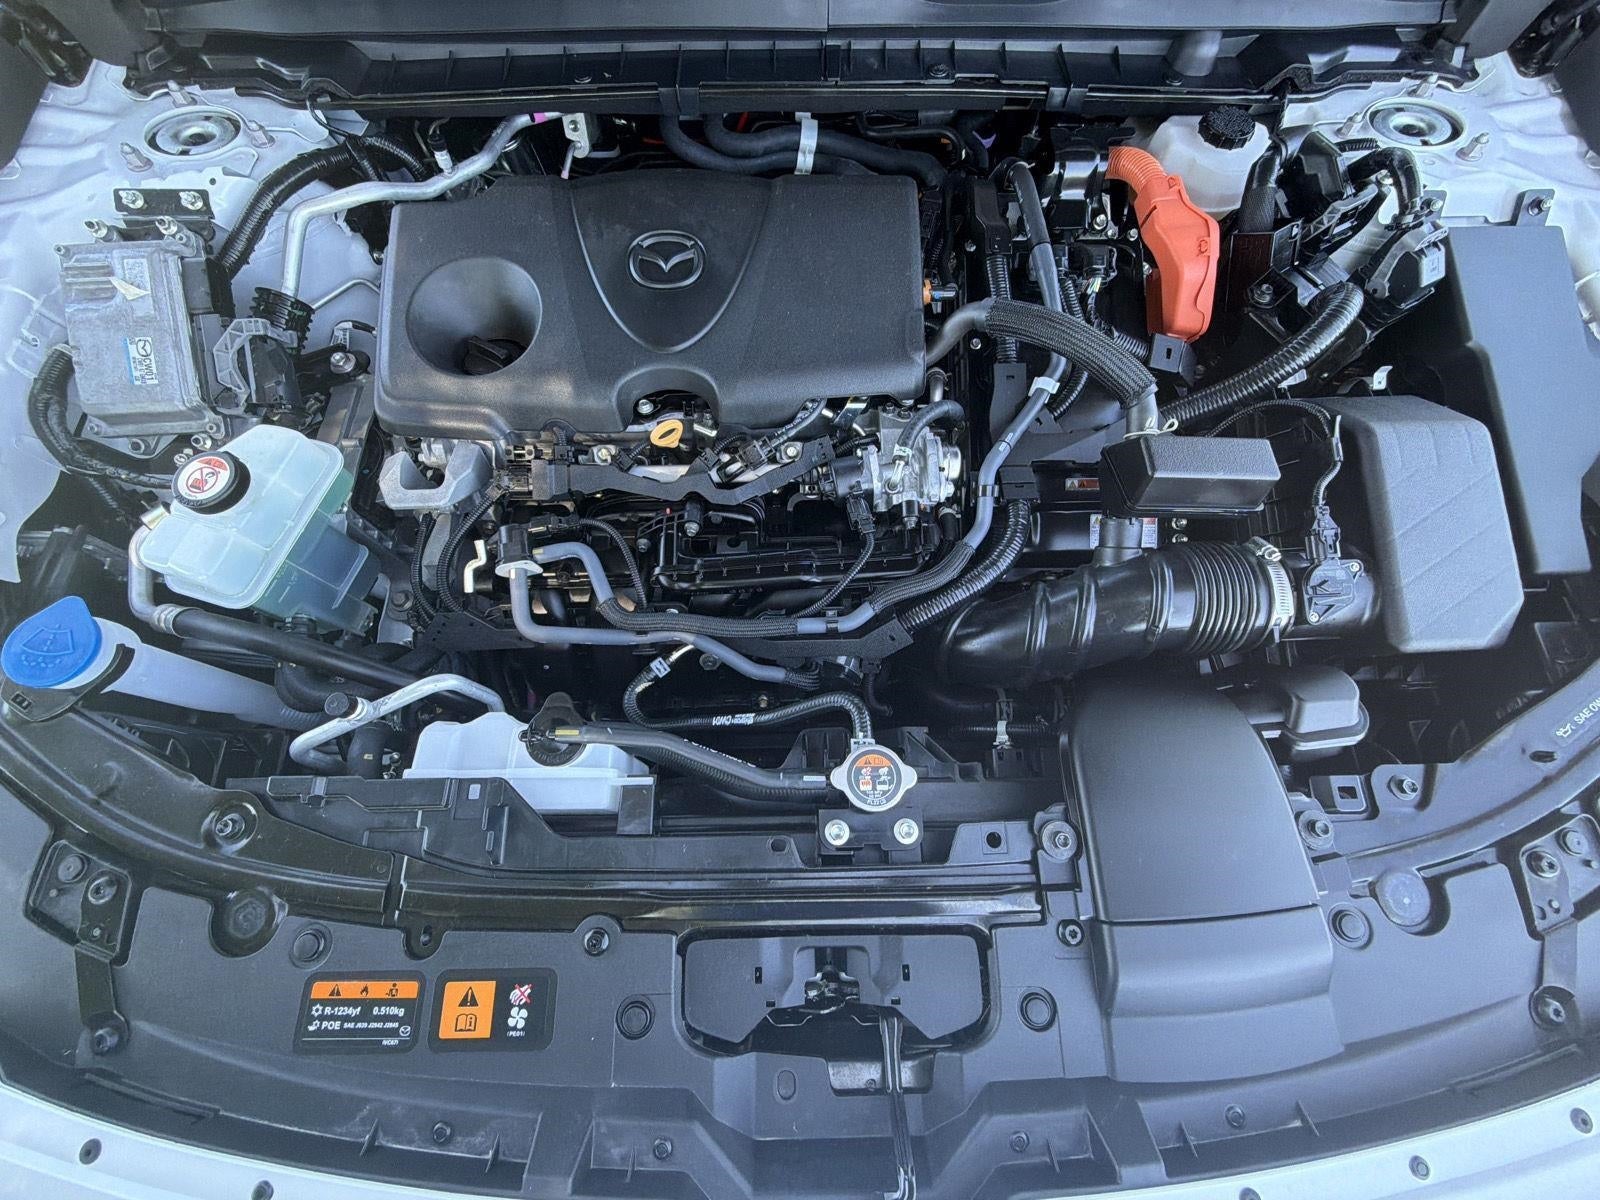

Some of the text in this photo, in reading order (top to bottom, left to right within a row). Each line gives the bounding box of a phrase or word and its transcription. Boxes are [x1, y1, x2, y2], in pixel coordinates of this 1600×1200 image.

[1574, 707, 1594, 724] SAE
[324, 1006, 404, 1017] R-1234yf 0.510kg
[321, 1021, 341, 1030] POE
